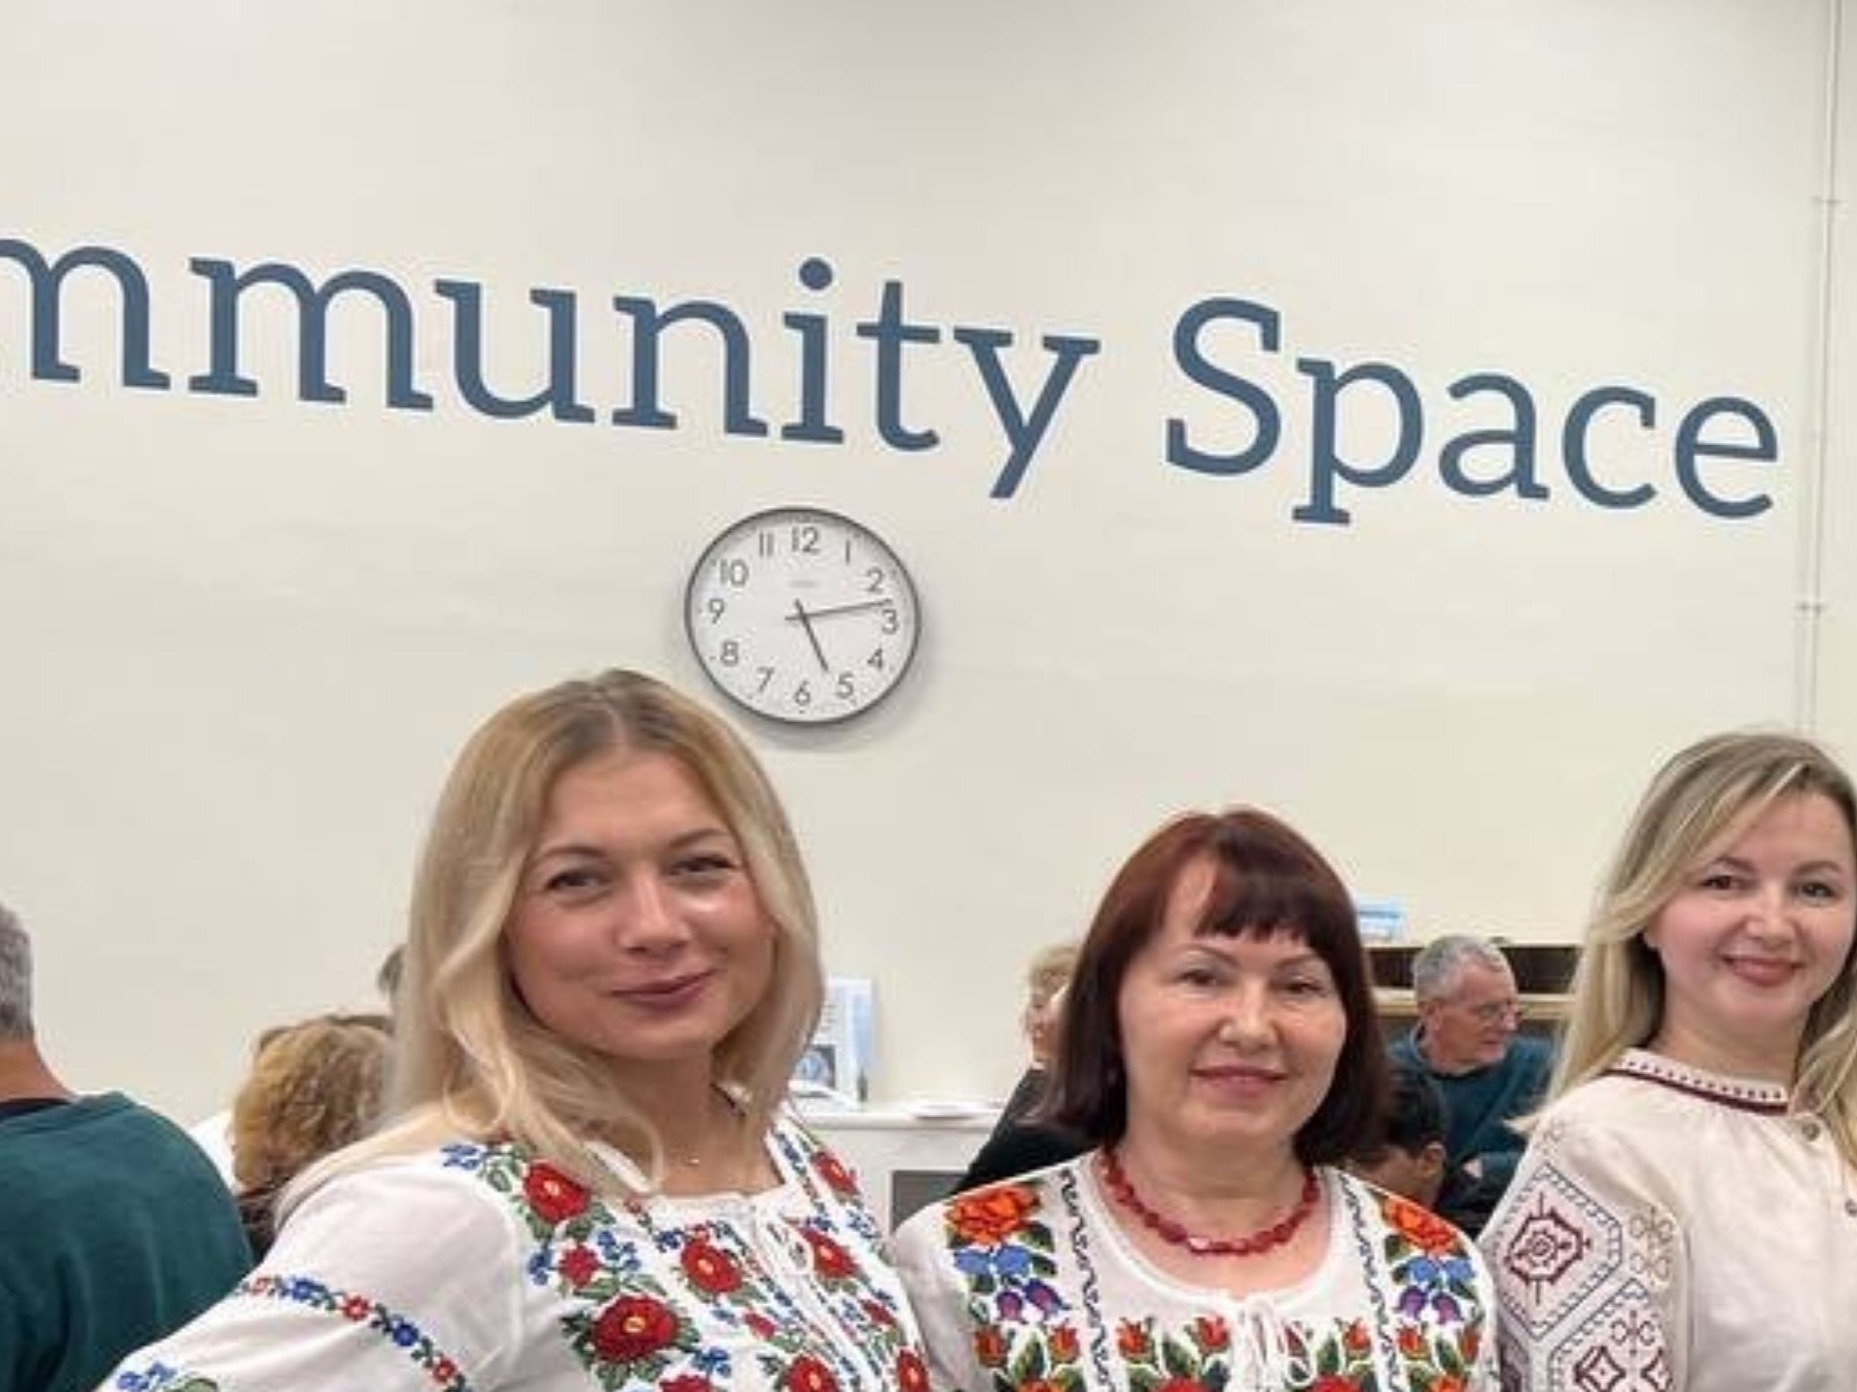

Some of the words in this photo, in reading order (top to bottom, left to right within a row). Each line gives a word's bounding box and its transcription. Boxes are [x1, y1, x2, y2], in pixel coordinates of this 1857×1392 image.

[1167, 299, 1778, 524] Space
[759, 532, 774, 557] 11
[791, 526, 820, 553] 12
[719, 559, 748, 586] 10
[866, 567, 884, 593] 2
[708, 599, 725, 624] 9
[882, 608, 898, 634] 3
[720, 641, 739, 667] 8
[867, 648, 884, 670] 4
[757, 666, 775, 692] 7
[836, 674, 854, 698] 5
[794, 680, 811, 705] 6
